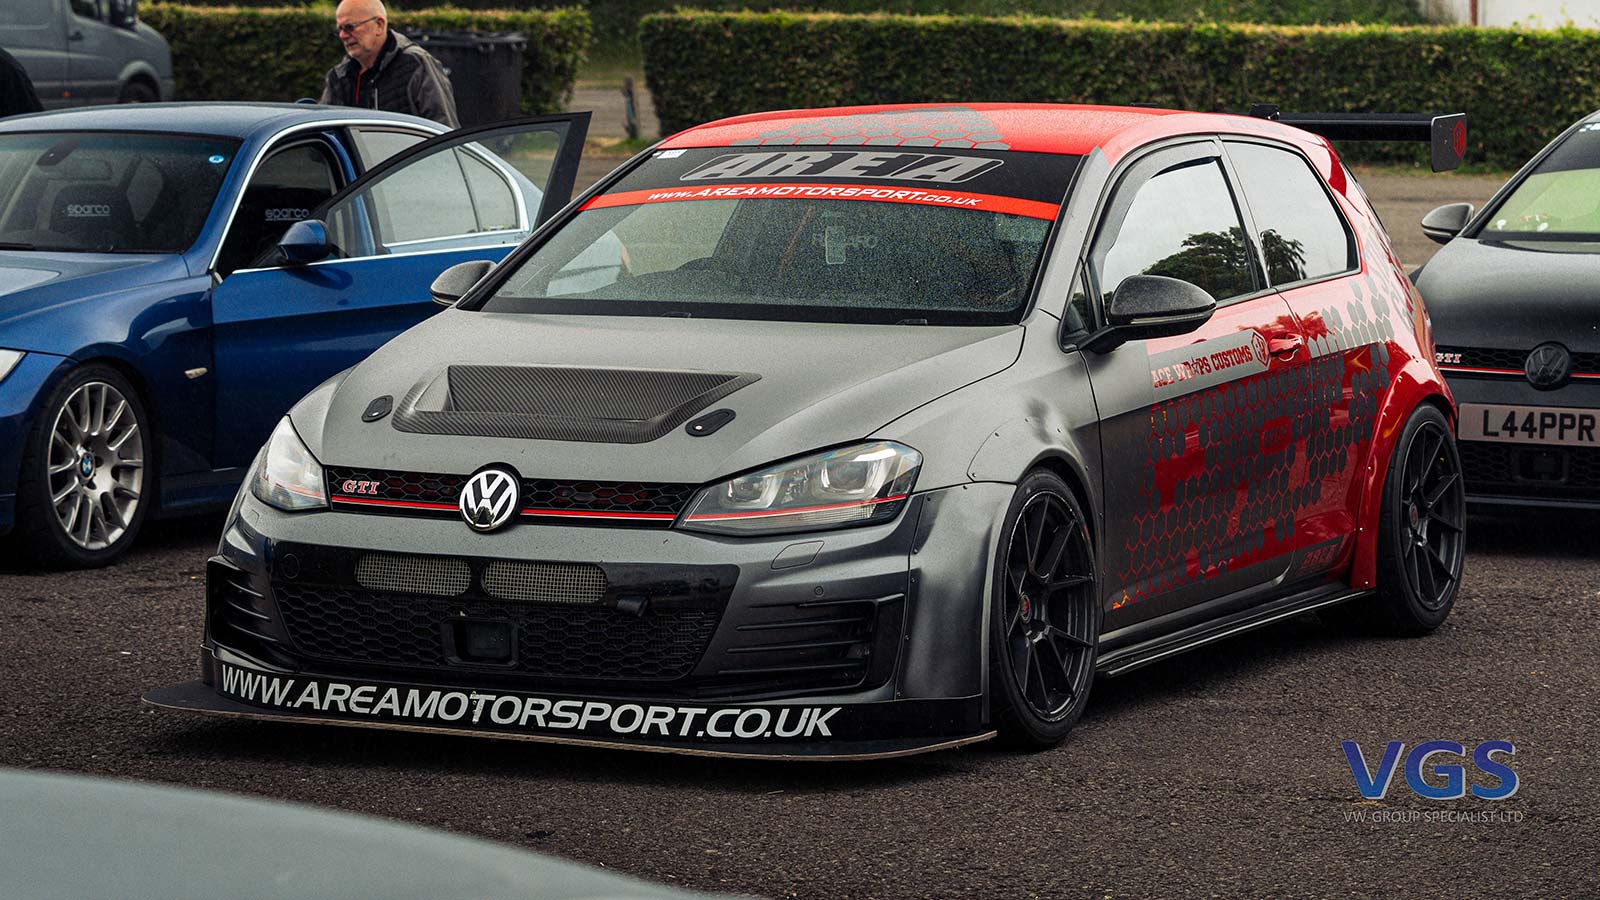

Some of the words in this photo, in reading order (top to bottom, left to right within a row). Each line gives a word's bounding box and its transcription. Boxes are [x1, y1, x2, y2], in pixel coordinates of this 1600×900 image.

[680, 151, 1004, 183] AREA
[67, 204, 111, 216] sparco
[266, 208, 310, 220] sparco
[1151, 369, 1175, 388] ACE
[1210, 345, 1253, 371] CUSTOMS
[1435, 352, 1462, 364] GTI
[1483, 410, 1596, 442] L44PPR
[342, 479, 380, 494] GTI
[222, 664, 841, 738] WWW.AREAMOTORSPORT.CO.UK
